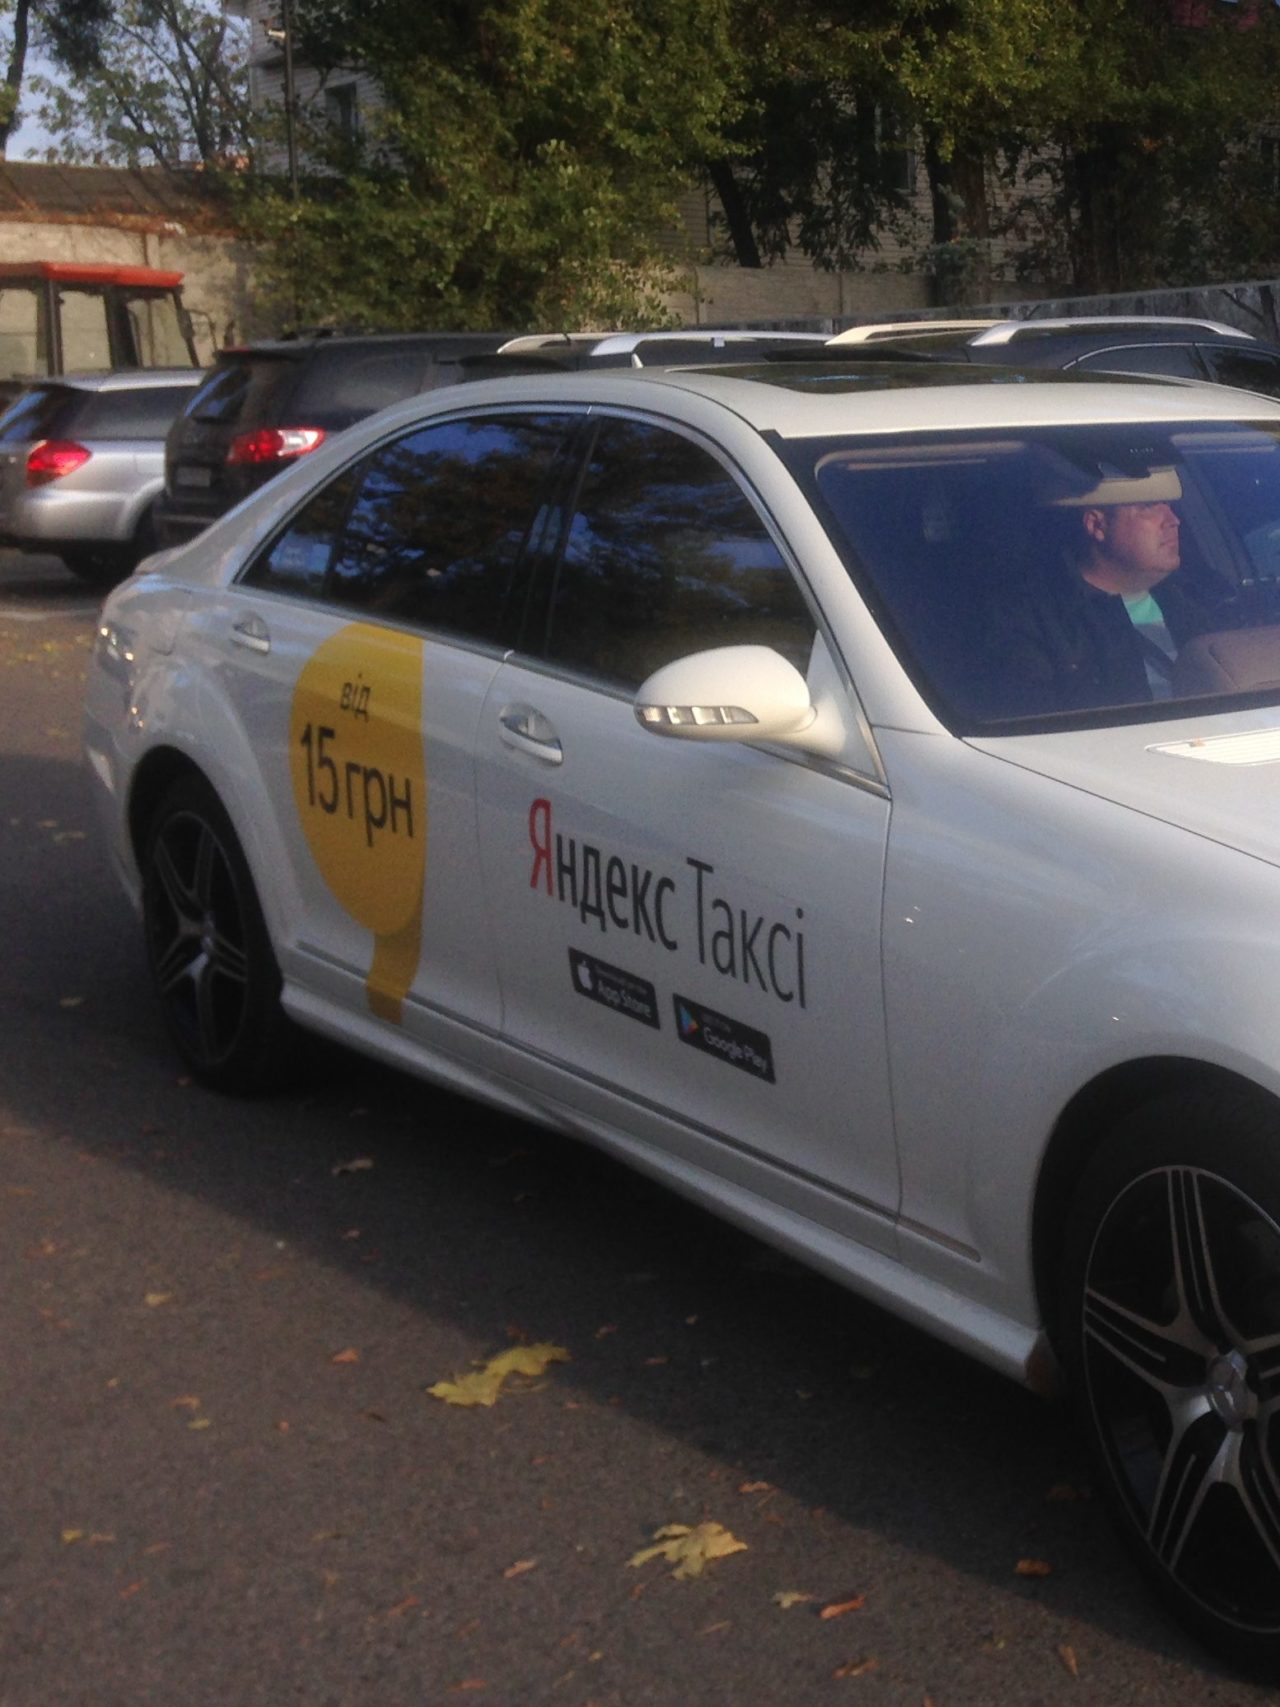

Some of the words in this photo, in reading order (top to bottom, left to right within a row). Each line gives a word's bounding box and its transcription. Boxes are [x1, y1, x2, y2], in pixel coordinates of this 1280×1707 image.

[340, 674, 371, 722] від
[528, 798, 678, 951] Яндекс
[686, 857, 806, 1009] Таксі
